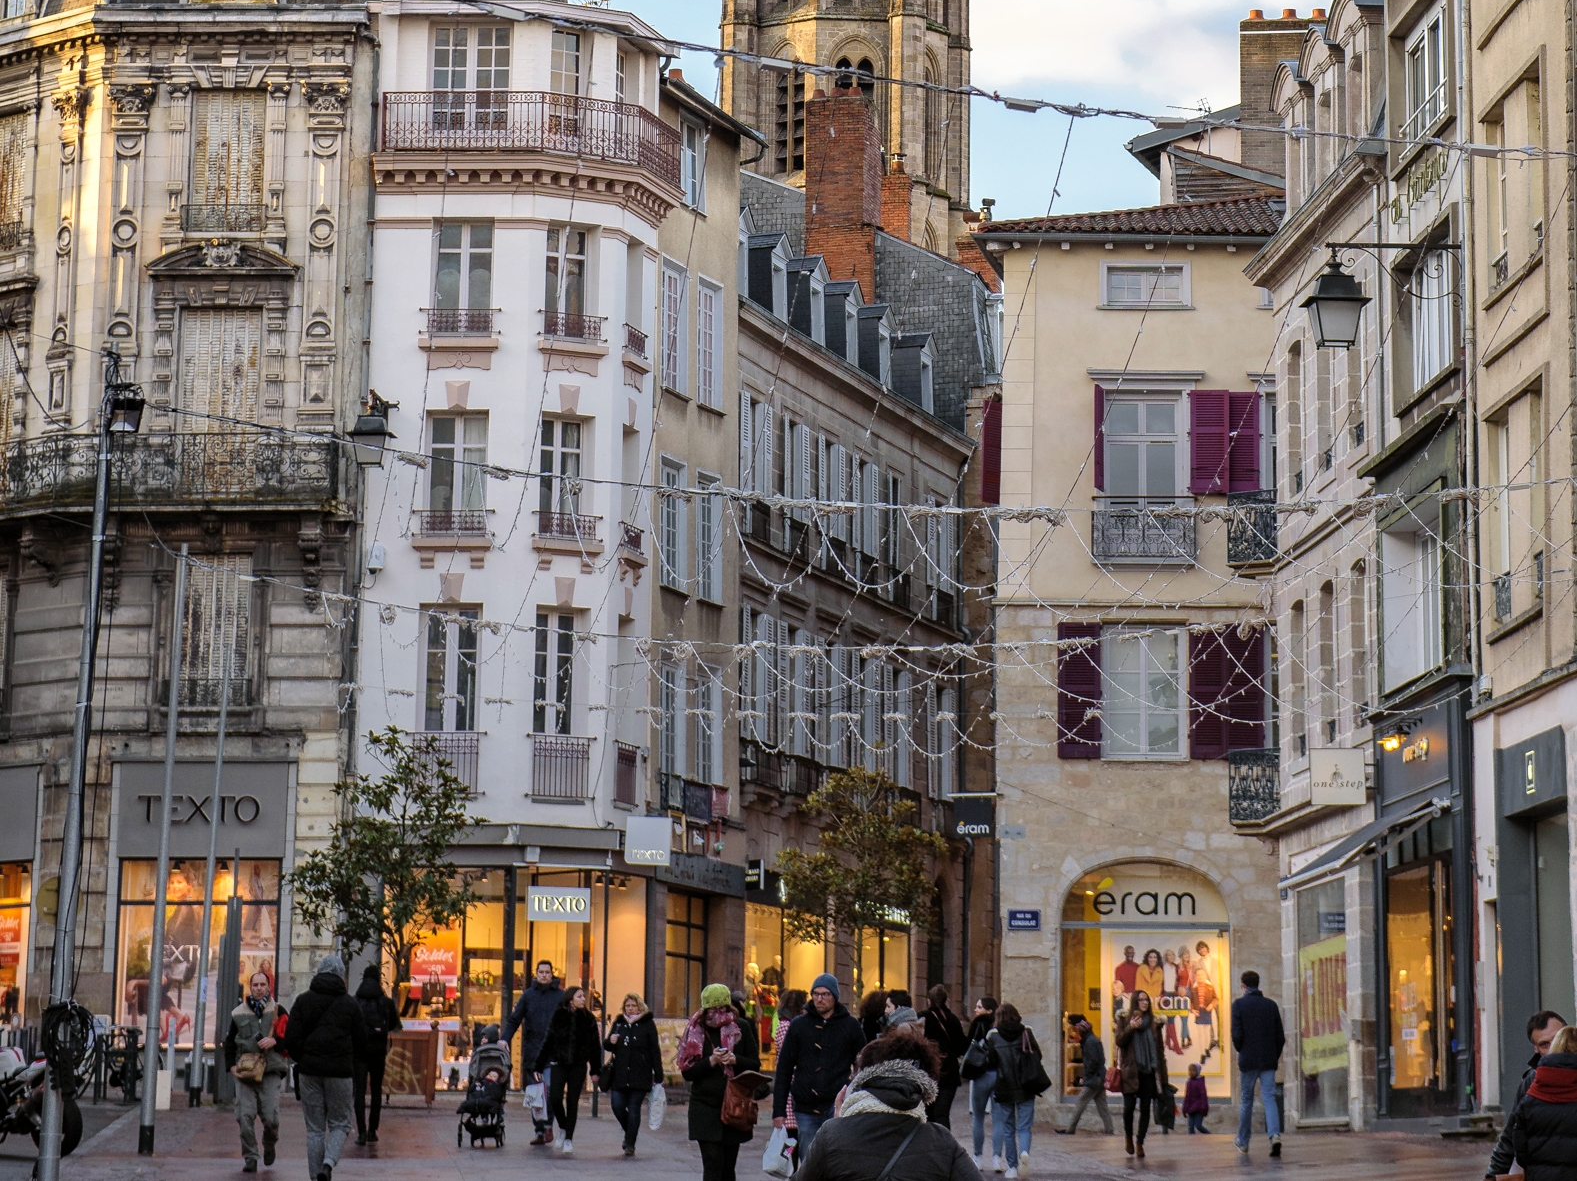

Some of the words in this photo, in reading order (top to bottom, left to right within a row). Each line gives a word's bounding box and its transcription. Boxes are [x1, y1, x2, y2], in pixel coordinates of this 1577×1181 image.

[1313, 780, 1335, 788] one
[1341, 779, 1363, 789] step
[138, 795, 260, 824] TEXTO
[956, 820, 990, 834] éram
[631, 849, 666, 861] TEXTO
[531, 895, 587, 913] TEXTO
[1093, 877, 1196, 916] éram
[415, 946, 454, 963] Soldes
[1150, 996, 1191, 1010] ram
